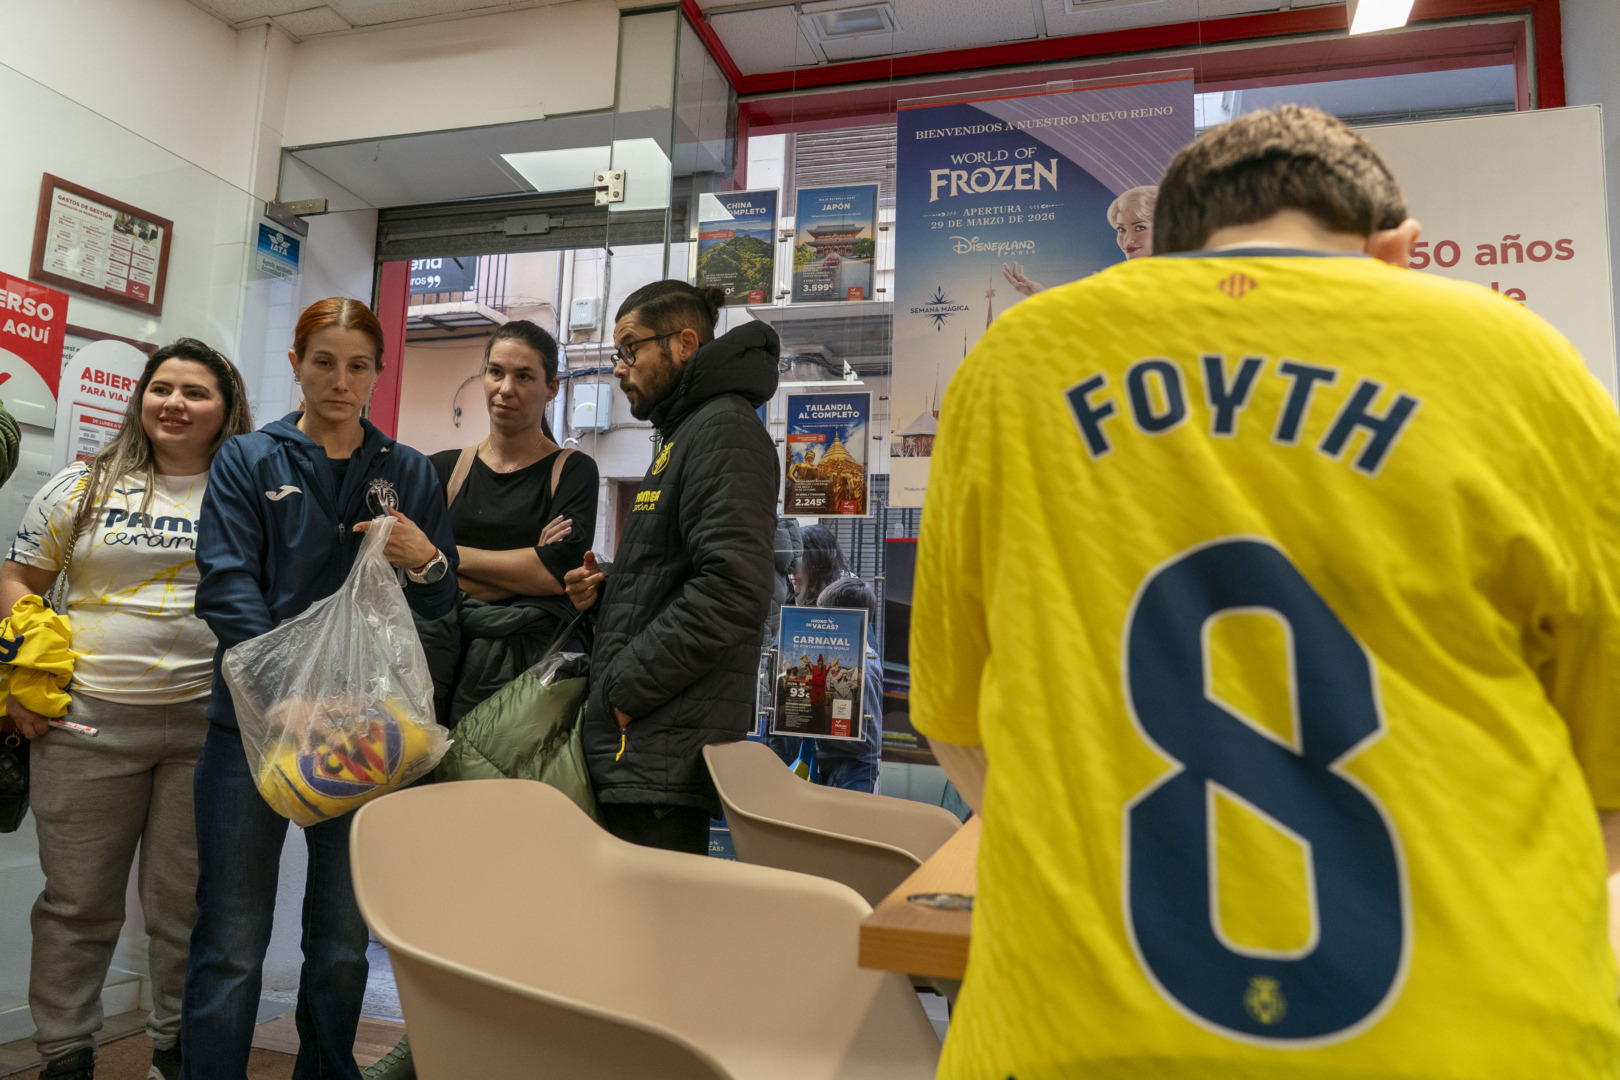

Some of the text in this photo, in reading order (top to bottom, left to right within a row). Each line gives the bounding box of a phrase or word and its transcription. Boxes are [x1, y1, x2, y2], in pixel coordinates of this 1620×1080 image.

[915, 105, 1174, 140] BIENVENIDOS A NUESTRO NUEVO REINO
[950, 146, 1038, 165] WORLD OF
[929, 158, 1059, 203] FROZEN
[57, 194, 81, 208] GASTOS
[81, 203, 89, 211] DE
[726, 201, 753, 210] CHINA
[821, 201, 851, 211] JAPÓN
[962, 204, 1022, 217] APERTURA
[930, 212, 1056, 230] 29 DE MARZO DE 2026
[270, 243, 288, 256] IATA
[1003, 249, 1036, 257] PARIS
[1409, 233, 1575, 270] 50 años
[802, 283, 834, 292] 3.599€
[1491, 282, 1527, 307] e
[910, 303, 970, 315] SEMANA MÁGICA
[2, 318, 52, 345] AQUÍ
[80, 384, 106, 398] PARA
[805, 403, 853, 412] TAILANDIA
[798, 410, 860, 420] AL COMPLETO
[1063, 352, 1422, 479] FOYTH
[795, 497, 826, 507] 2.245€
[811, 622, 839, 631] VACAS?
[793, 635, 851, 646] CARNAVAL
[1122, 535, 1413, 1048] 8
